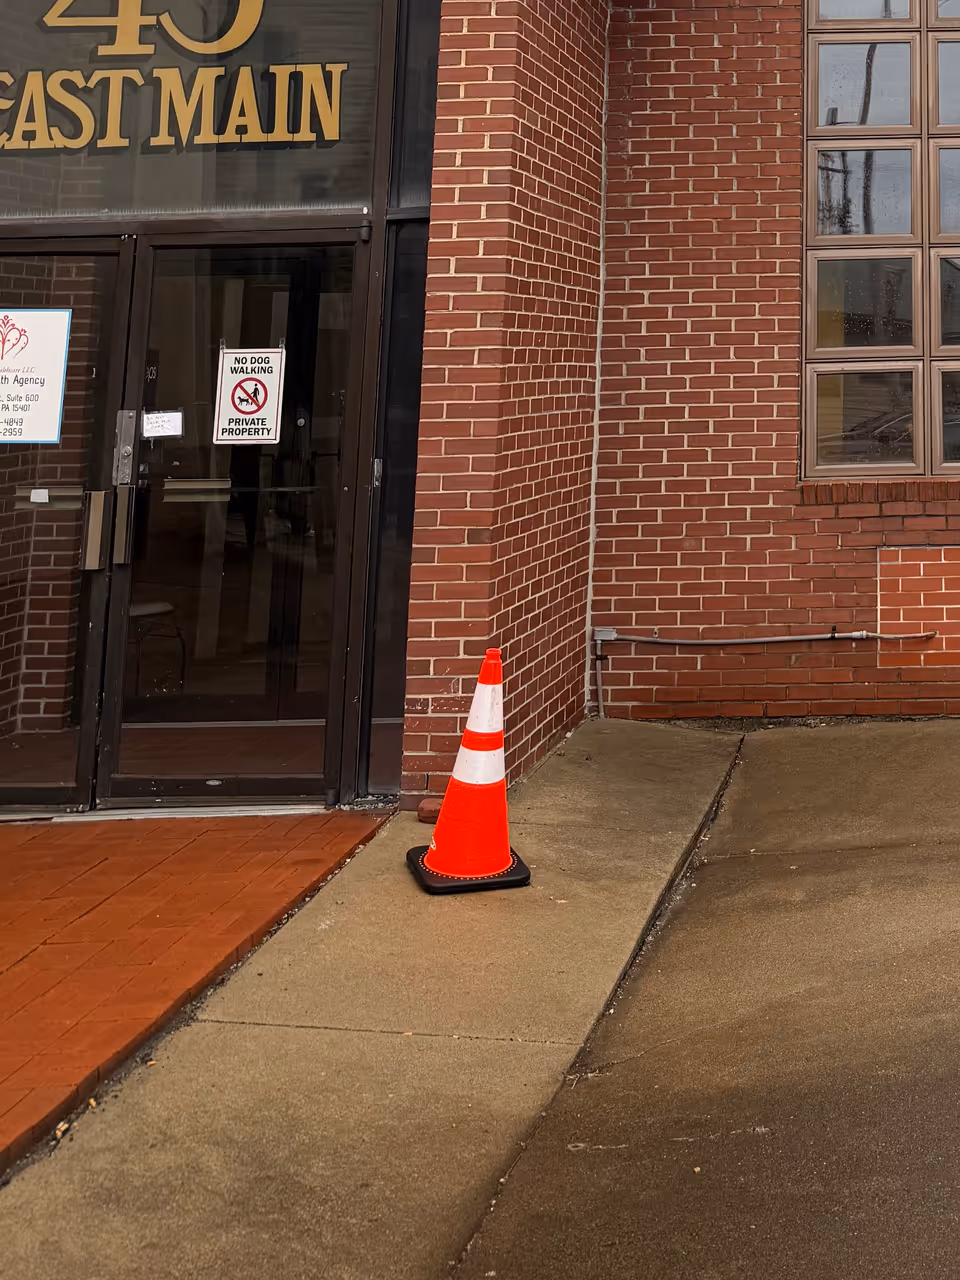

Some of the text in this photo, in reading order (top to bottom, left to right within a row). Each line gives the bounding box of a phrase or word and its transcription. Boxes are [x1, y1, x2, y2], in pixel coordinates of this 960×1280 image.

[150, 62, 348, 148] MAIN
[234, 356, 270, 365] NO DOG
[230, 366, 274, 375] WALKING
[12, 374, 46, 388] Agency
[6, 393, 23, 402] Suite
[25, 393, 40, 402] 600
[1, 403, 31, 412] PA 15401
[228, 417, 267, 427] PRIVATE
[221, 427, 272, 437] PROPERTY
